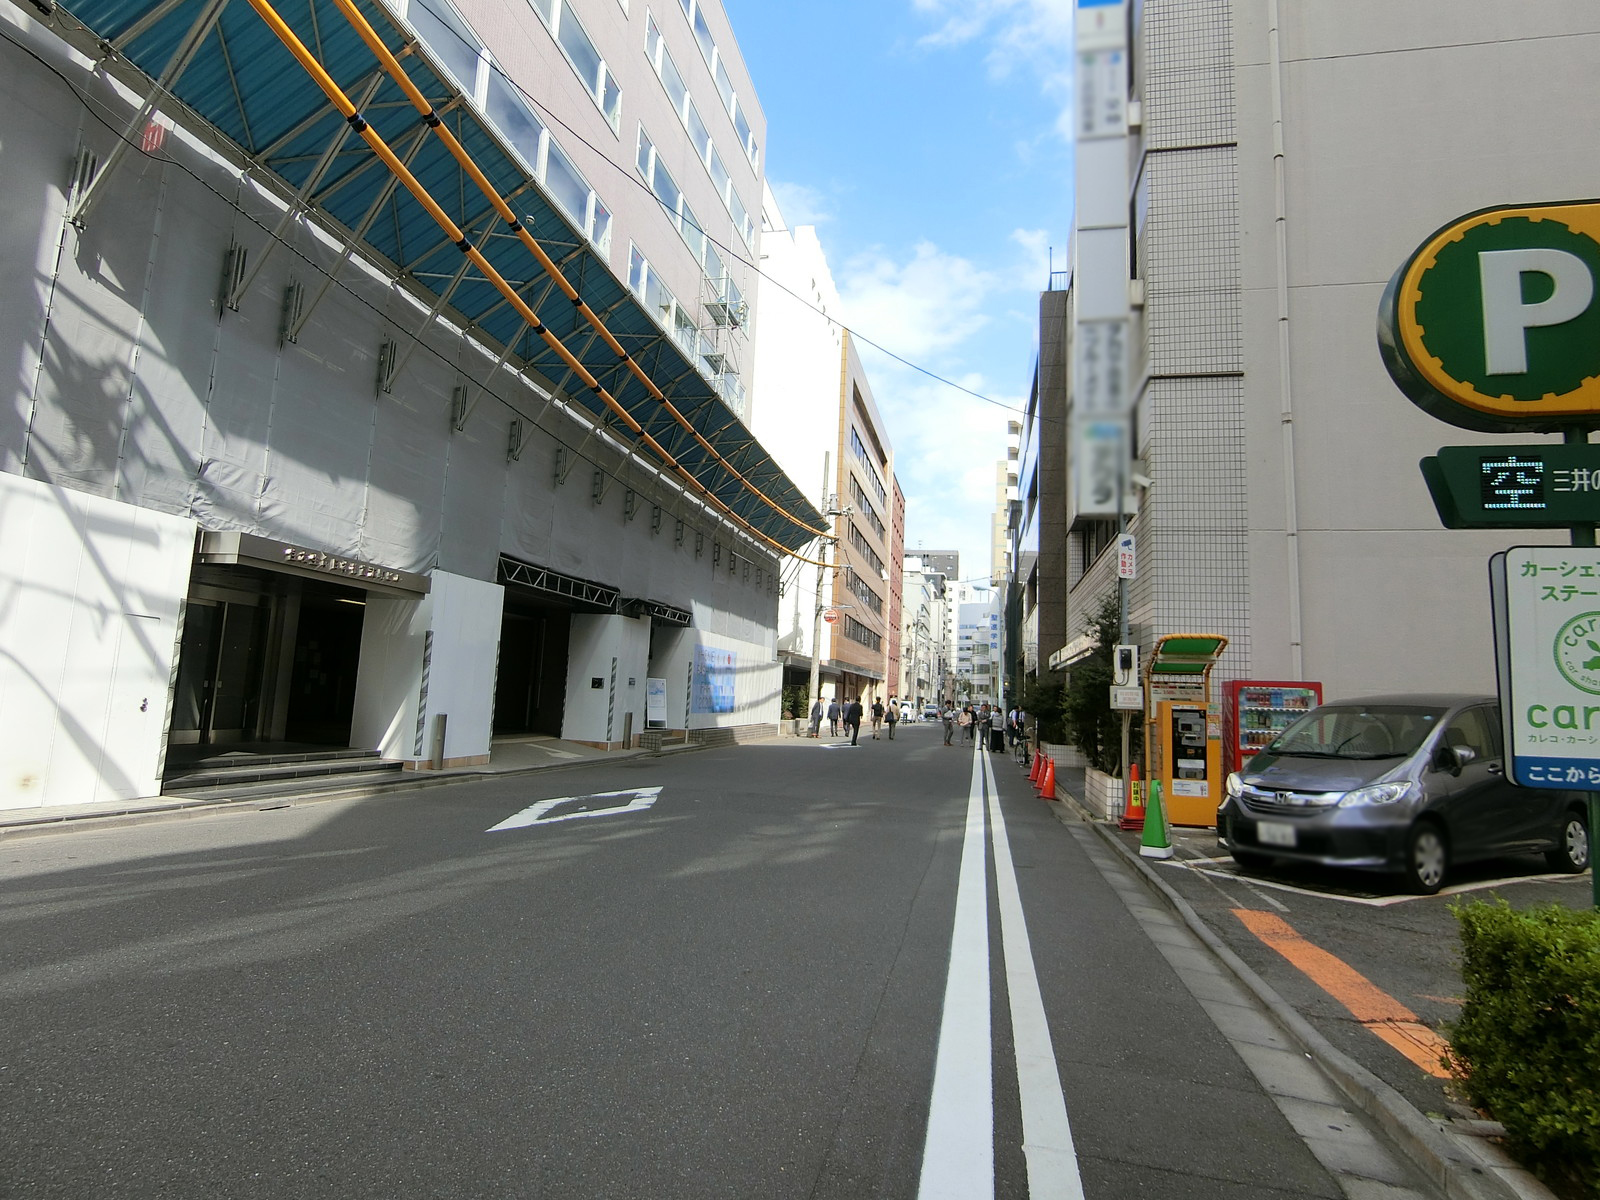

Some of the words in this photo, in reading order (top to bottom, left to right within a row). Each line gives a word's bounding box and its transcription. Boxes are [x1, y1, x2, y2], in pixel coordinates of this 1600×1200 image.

[1478, 248, 1594, 376] P
[1482, 456, 1546, 508] 空
[1520, 561, 1600, 577] カーシェ
[1564, 618, 1600, 647] car
[1580, 675, 1600, 686] sha
[1528, 734, 1600, 745] カレコ・カーシ
[1528, 766, 1600, 784] ここから
